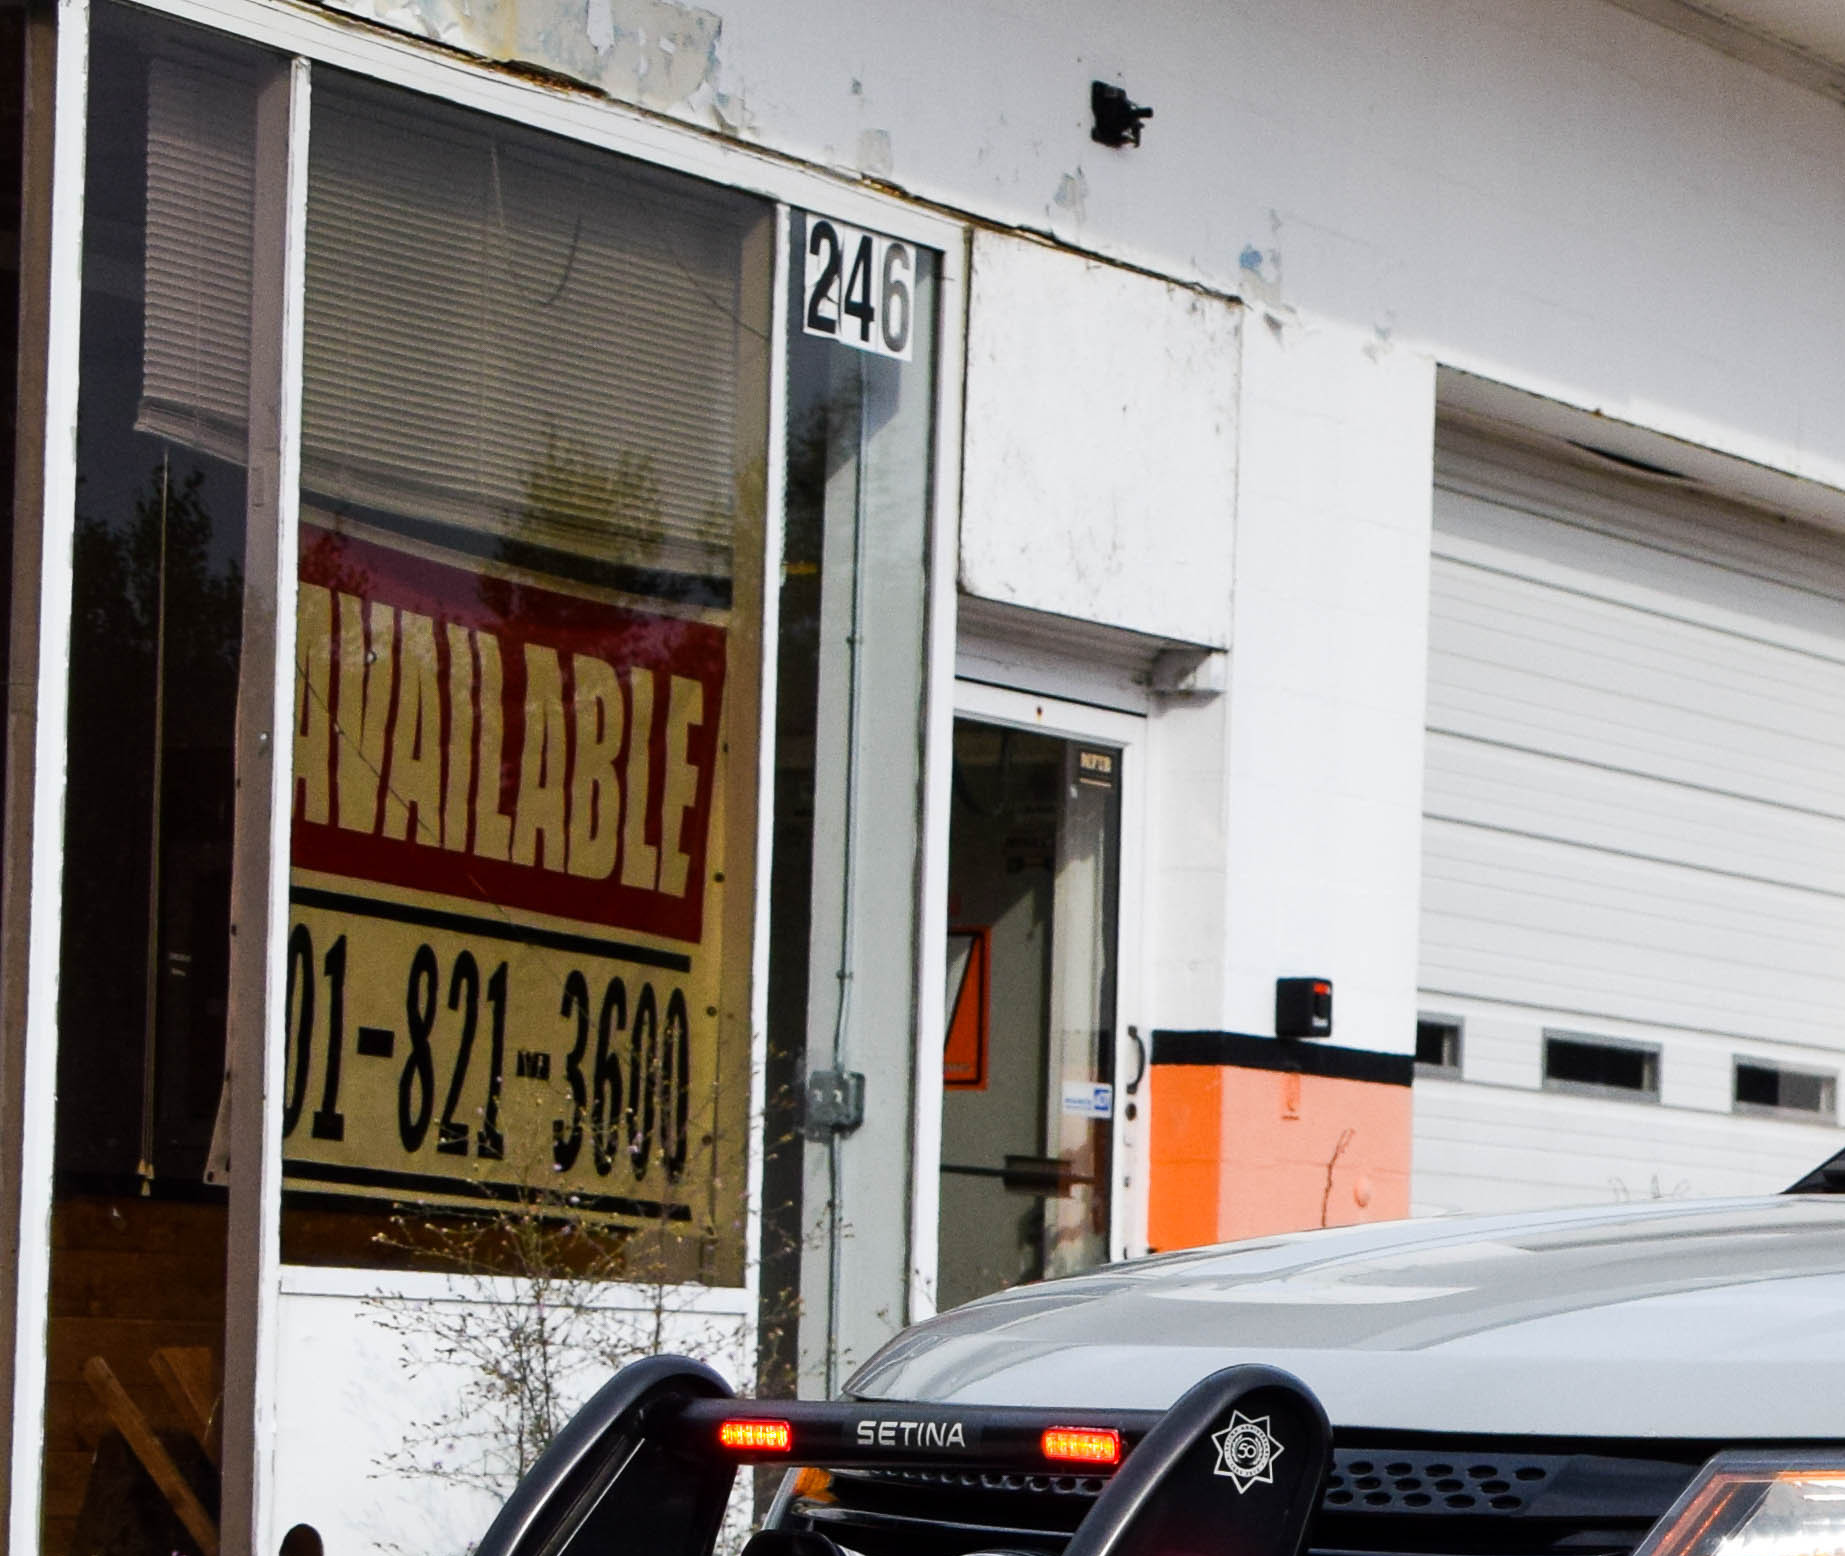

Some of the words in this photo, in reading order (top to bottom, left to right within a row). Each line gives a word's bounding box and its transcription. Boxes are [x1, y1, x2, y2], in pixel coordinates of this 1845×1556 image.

[808, 220, 912, 352] 246
[292, 581, 704, 897] AVAILABLE
[857, 1420, 966, 1447] SETINA
[1237, 1442, 1257, 1459] 50
